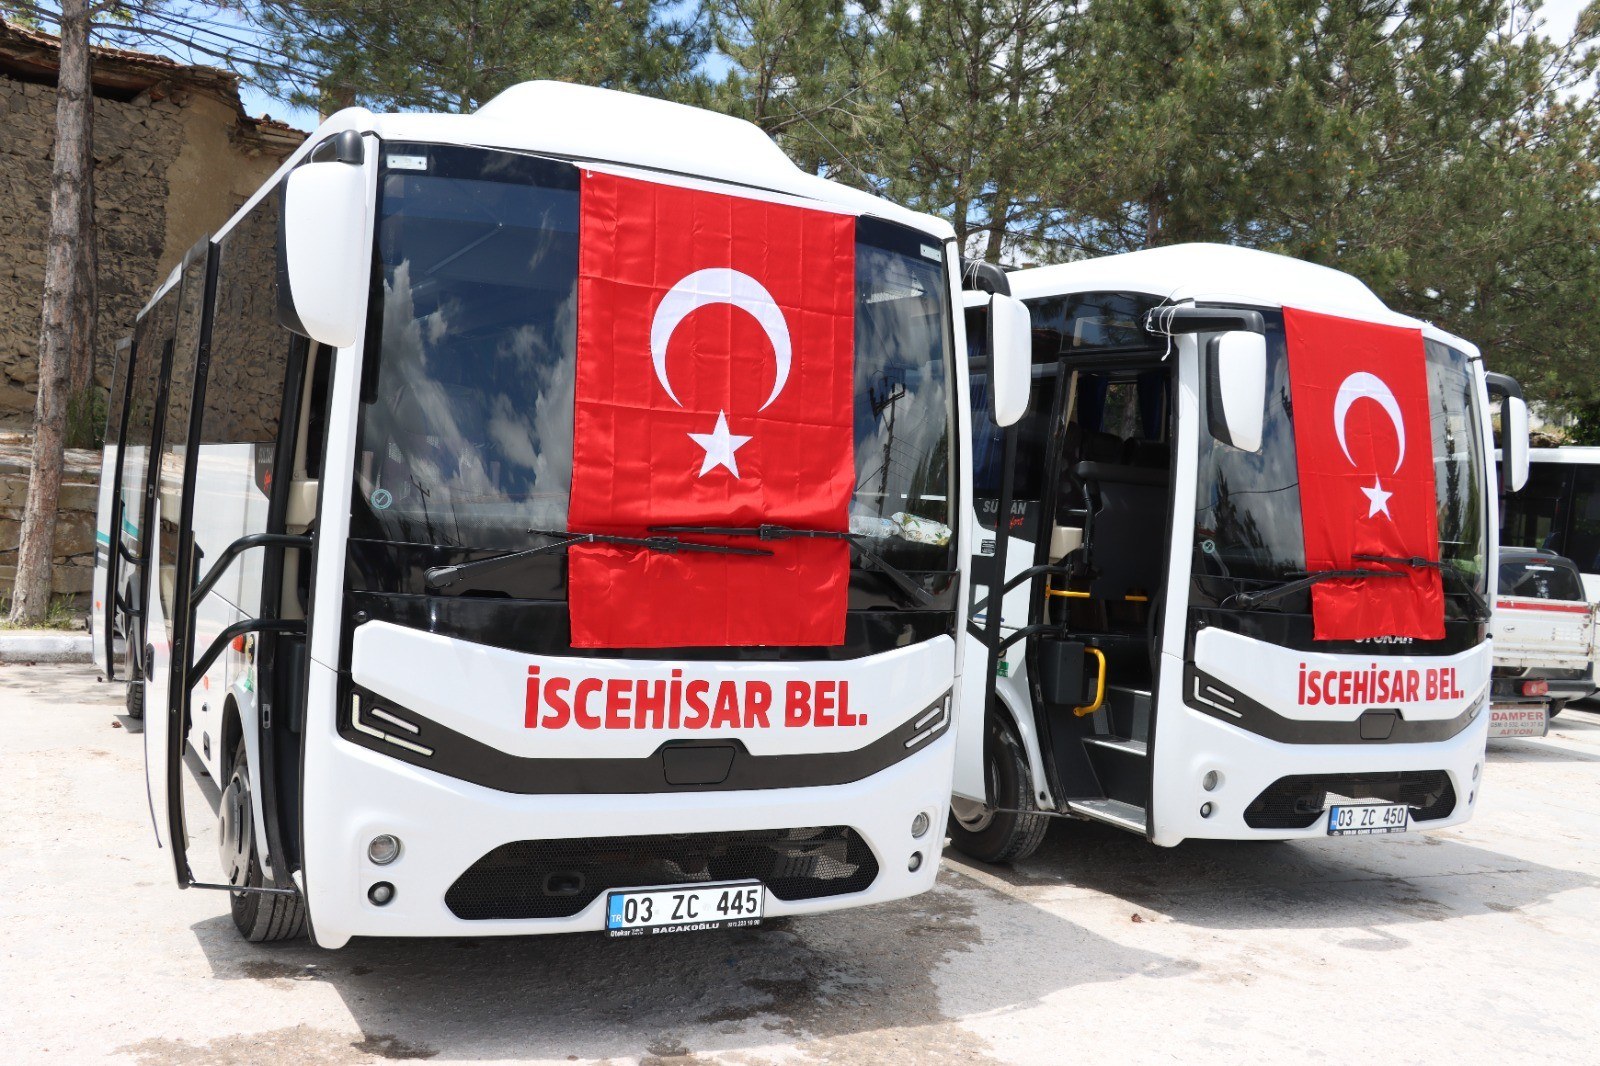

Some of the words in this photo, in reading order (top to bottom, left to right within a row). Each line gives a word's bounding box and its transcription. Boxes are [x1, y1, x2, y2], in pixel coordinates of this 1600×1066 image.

[982, 500, 1027, 514] SUAN
[1298, 662, 1420, 706] İSCEHİSAR
[1425, 668, 1465, 701] BEL.
[524, 664, 773, 730] İSCEHİSAR
[784, 680, 868, 728] BEL.
[1491, 711, 1544, 721] DAMPER
[1338, 809, 1353, 827] 03
[1360, 808, 1376, 826] ZC
[1383, 807, 1404, 825] 450
[624, 897, 653, 924] 03
[671, 894, 700, 920] ZC
[716, 889, 758, 916] 445
[611, 914, 622, 923] TR
[652, 922, 720, 934] BACAKOĞLU
